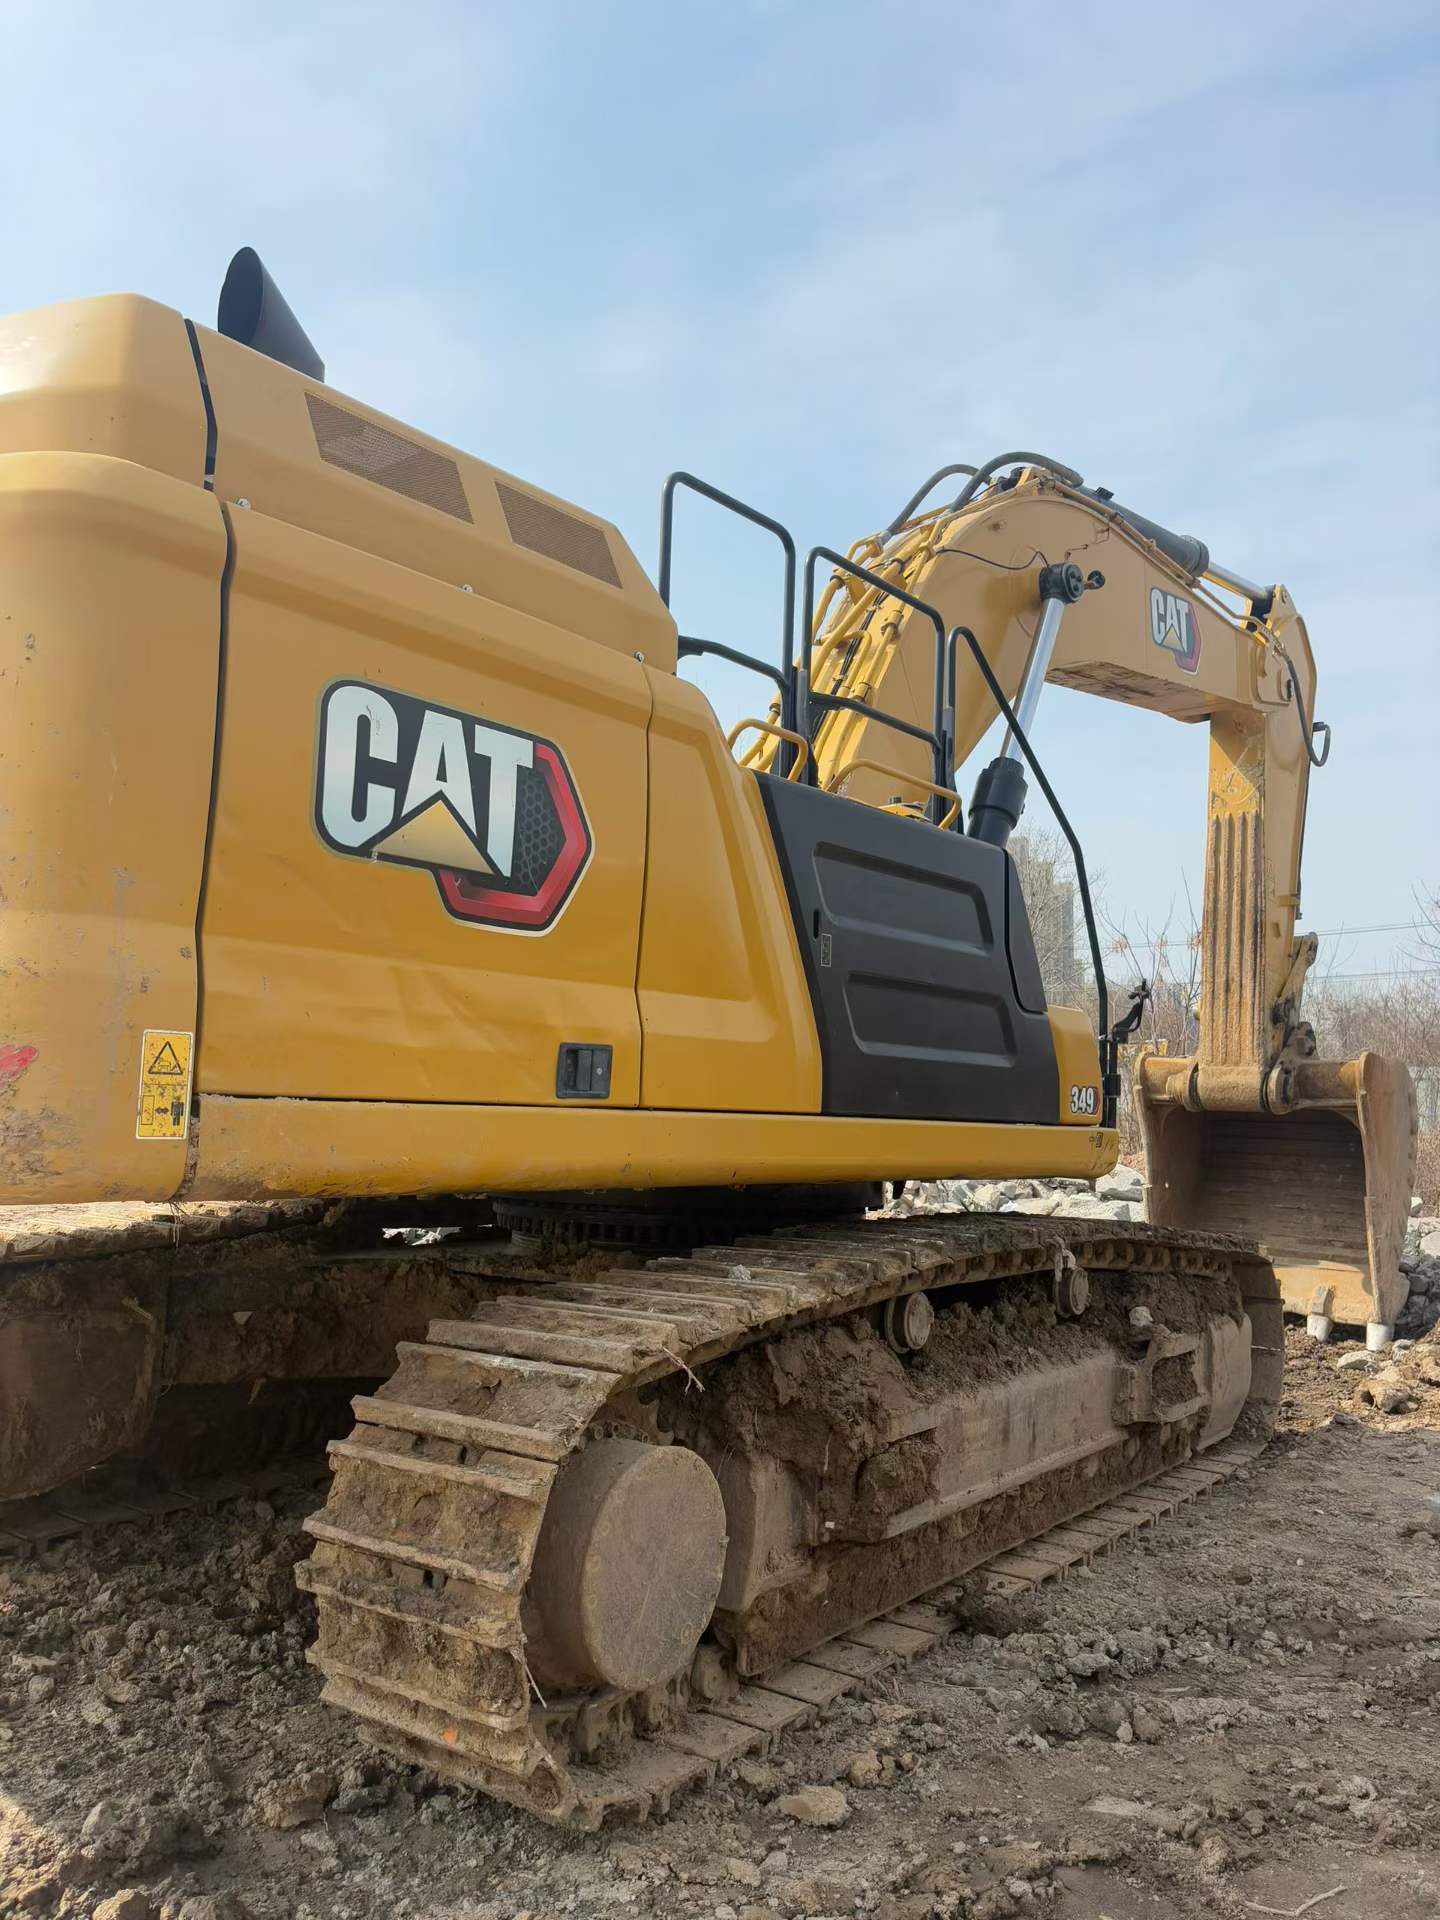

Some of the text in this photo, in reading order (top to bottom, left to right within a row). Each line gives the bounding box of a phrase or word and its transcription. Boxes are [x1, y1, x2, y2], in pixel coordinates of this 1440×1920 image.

[1151, 588, 1189, 654] CAT
[322, 685, 534, 878] CAT
[1071, 1086, 1095, 1114] 349
